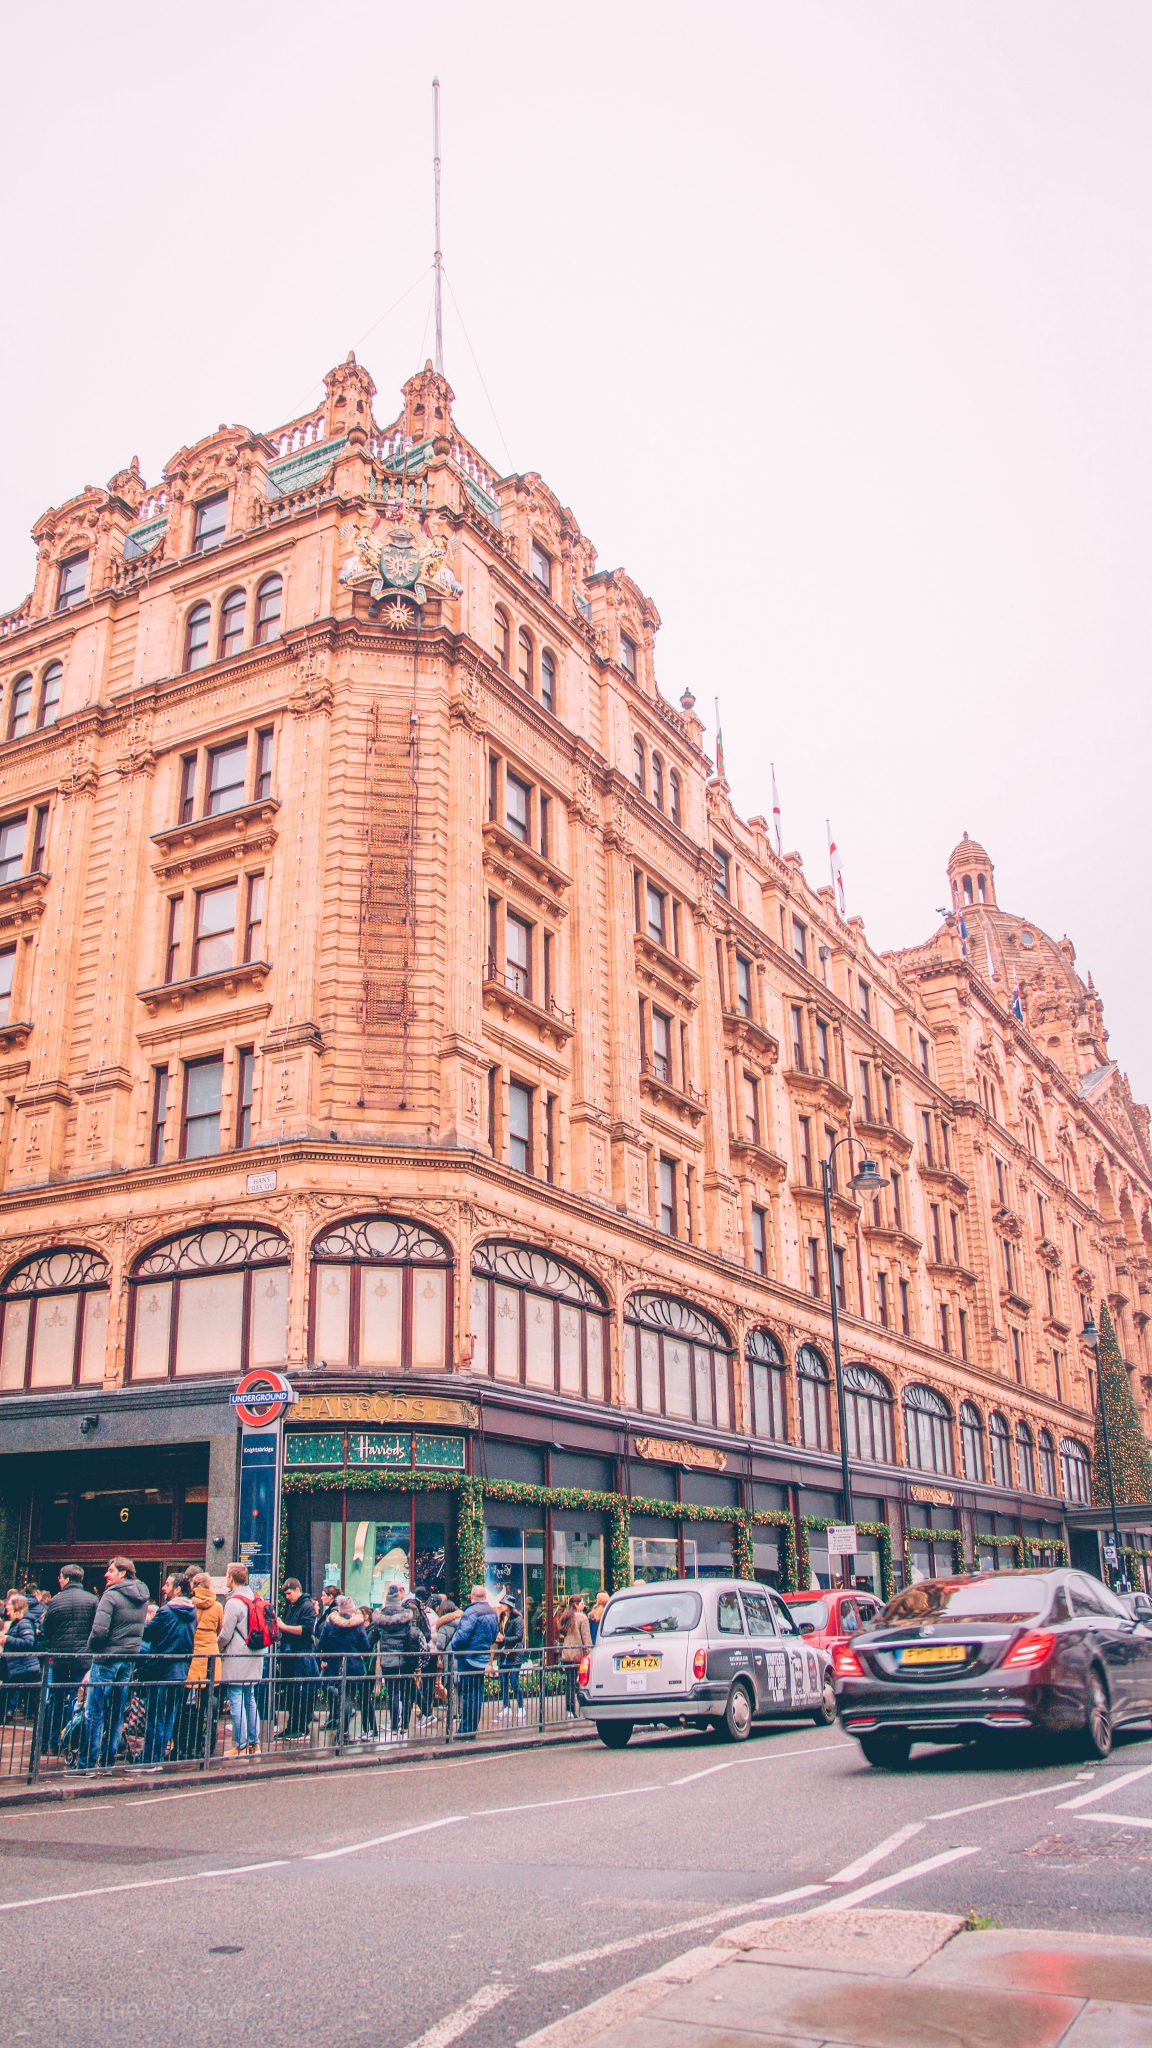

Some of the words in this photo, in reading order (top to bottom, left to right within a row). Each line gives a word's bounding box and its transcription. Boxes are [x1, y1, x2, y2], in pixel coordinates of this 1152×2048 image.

[231, 1392, 287, 1403] UNDERGROUND
[298, 1397, 426, 1420] HARRODS
[244, 1446, 274, 1454] Knightsbridge
[354, 1435, 406, 1460] Harrods
[120, 1507, 129, 1523] 6
[621, 1659, 640, 1669] LM54
[644, 1658, 659, 1667] TZX
